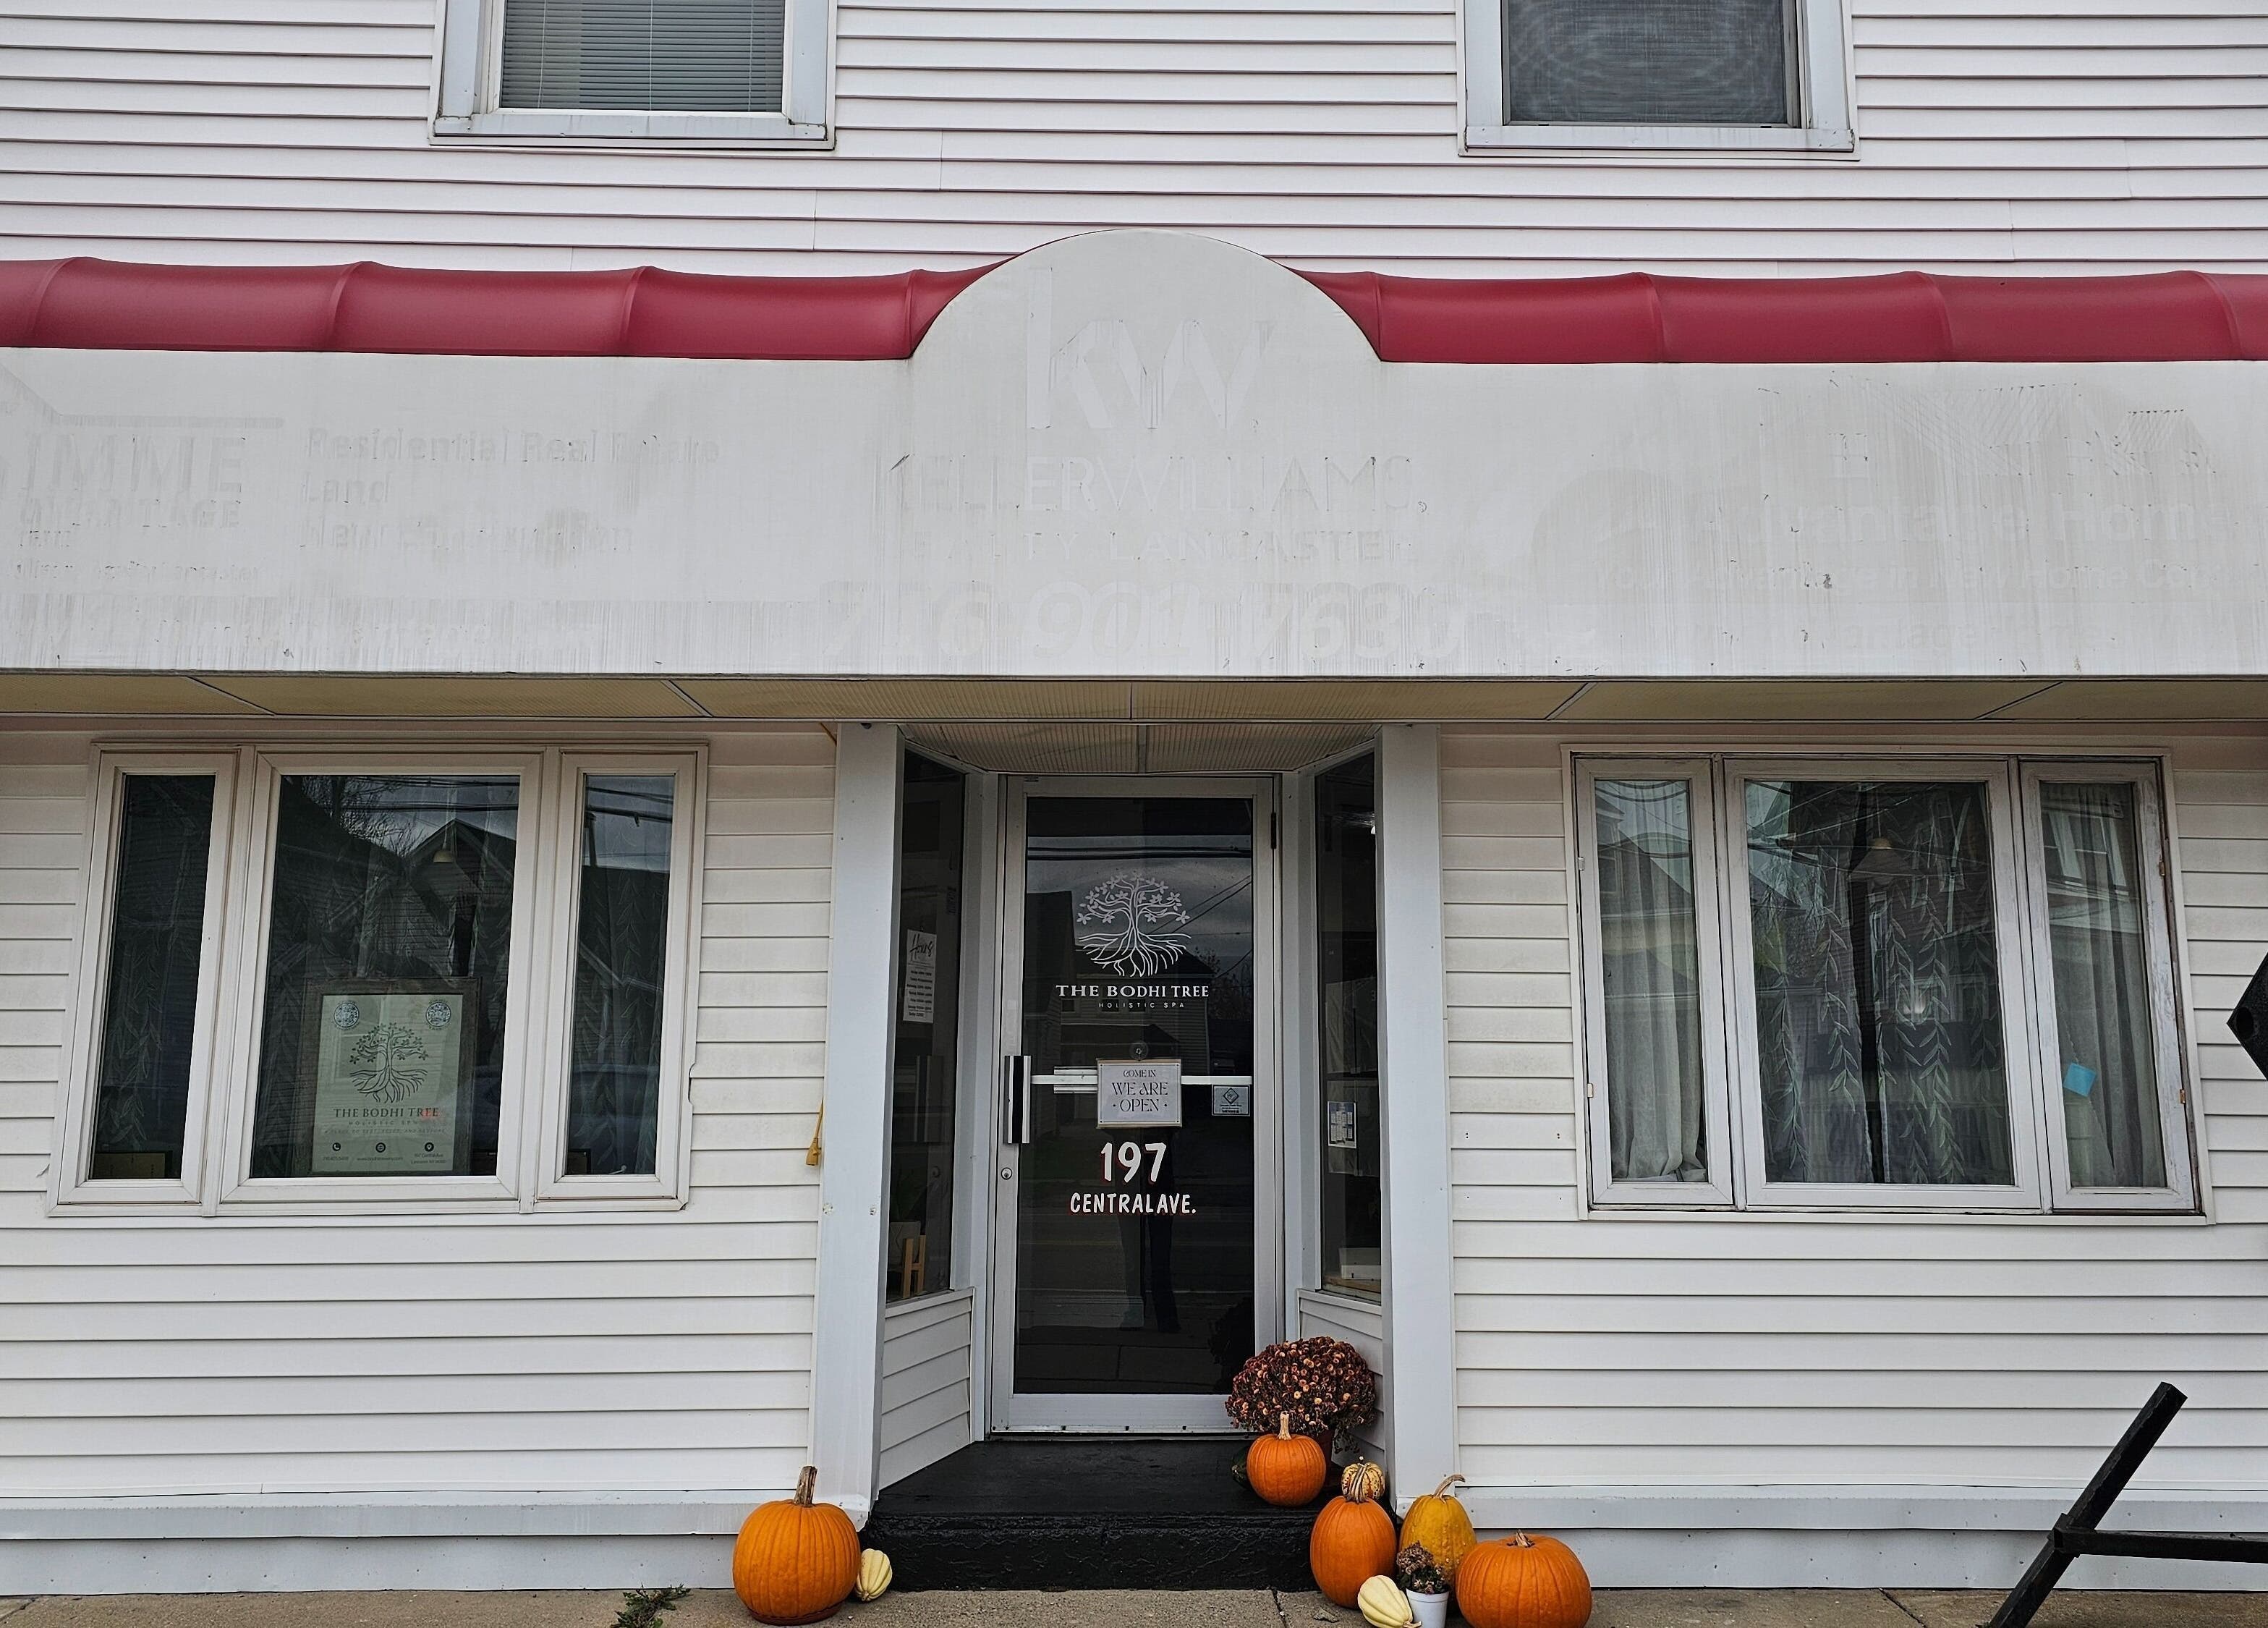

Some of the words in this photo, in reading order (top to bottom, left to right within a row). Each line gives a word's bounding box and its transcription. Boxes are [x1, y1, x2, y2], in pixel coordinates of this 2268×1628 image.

[1056, 985, 1100, 997] THE
[1107, 985, 1166, 998] BODHI
[1171, 985, 1210, 998] TREE
[1112, 1082, 1137, 1095] WE
[1139, 1082, 1168, 1095] ARE
[1119, 1098, 1159, 1112] OPEN
[334, 1108, 359, 1118] THE
[362, 1108, 403, 1118] BODHI
[409, 1107, 439, 1117] TREE
[1100, 1141, 1167, 1183] 197
